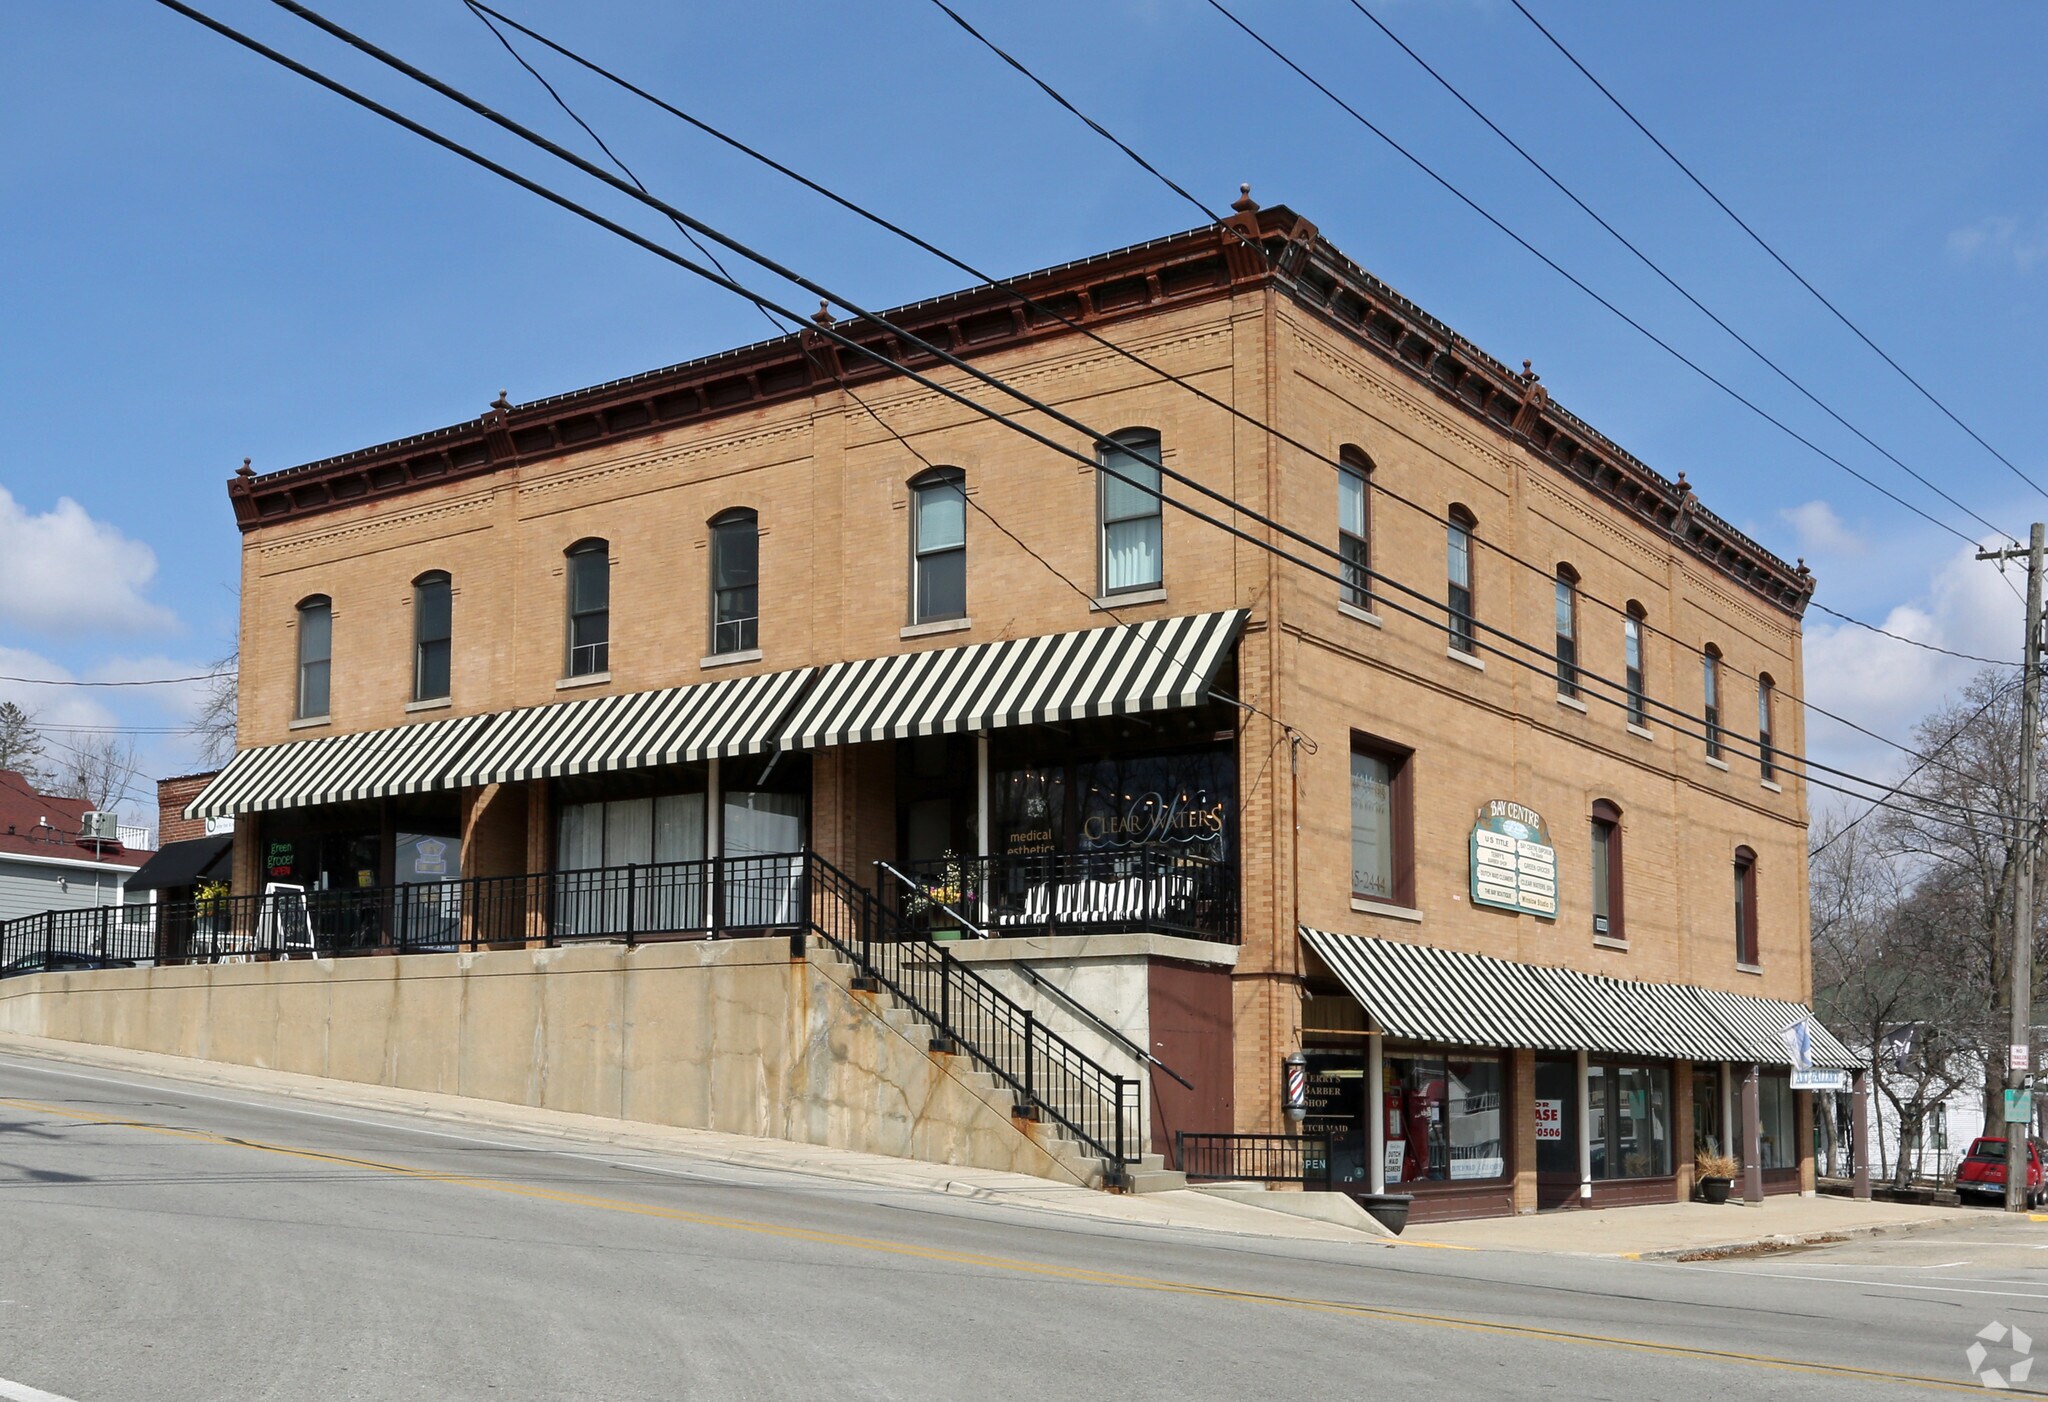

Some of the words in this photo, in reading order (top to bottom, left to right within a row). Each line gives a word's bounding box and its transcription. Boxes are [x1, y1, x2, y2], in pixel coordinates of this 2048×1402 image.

[1490, 801, 1506, 816] BAY
[1508, 803, 1539, 828] CENTRE
[1084, 816, 1141, 840] CLEAR
[1010, 828, 1052, 843] medical
[1495, 838, 1510, 847] TITLE
[271, 843, 292, 855] green
[1007, 844, 1055, 855] esthetics
[267, 855, 294, 869] grocer
[271, 866, 291, 876] OPEN
[1304, 1085, 1341, 1096] BARBER
[1535, 1109, 1558, 1121] ASE
[1536, 1128, 1560, 1137] -0506
[1303, 1160, 1326, 1169] PEN
